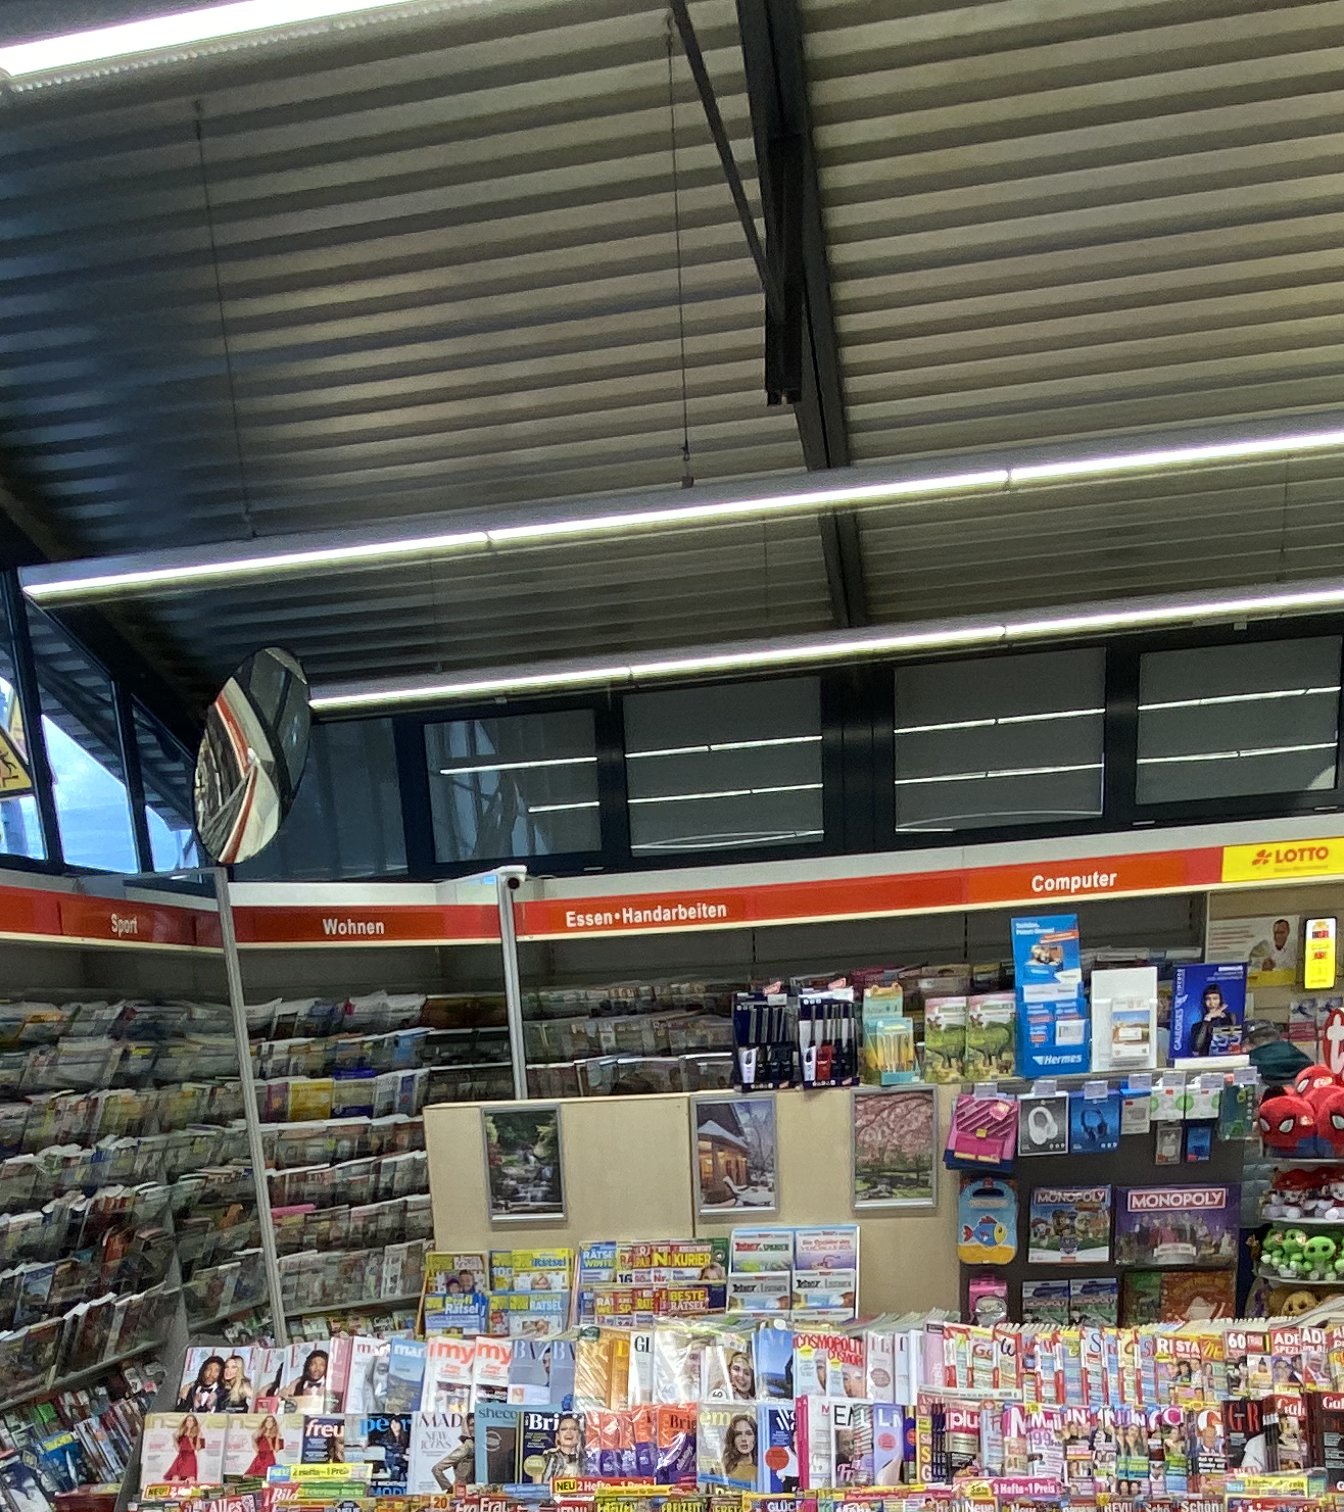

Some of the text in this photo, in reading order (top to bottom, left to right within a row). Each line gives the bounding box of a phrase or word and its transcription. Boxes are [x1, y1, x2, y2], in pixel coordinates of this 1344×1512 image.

[1275, 845, 1329, 865] LOTTO
[1031, 869, 1118, 892] Computer
[110, 912, 138, 935] Sport
[322, 917, 385, 935] Wohnen
[1043, 1053, 1083, 1066] Hermes
[1037, 1186, 1107, 1204] MONOPOLY
[1132, 1190, 1224, 1209] MONOPOLY
